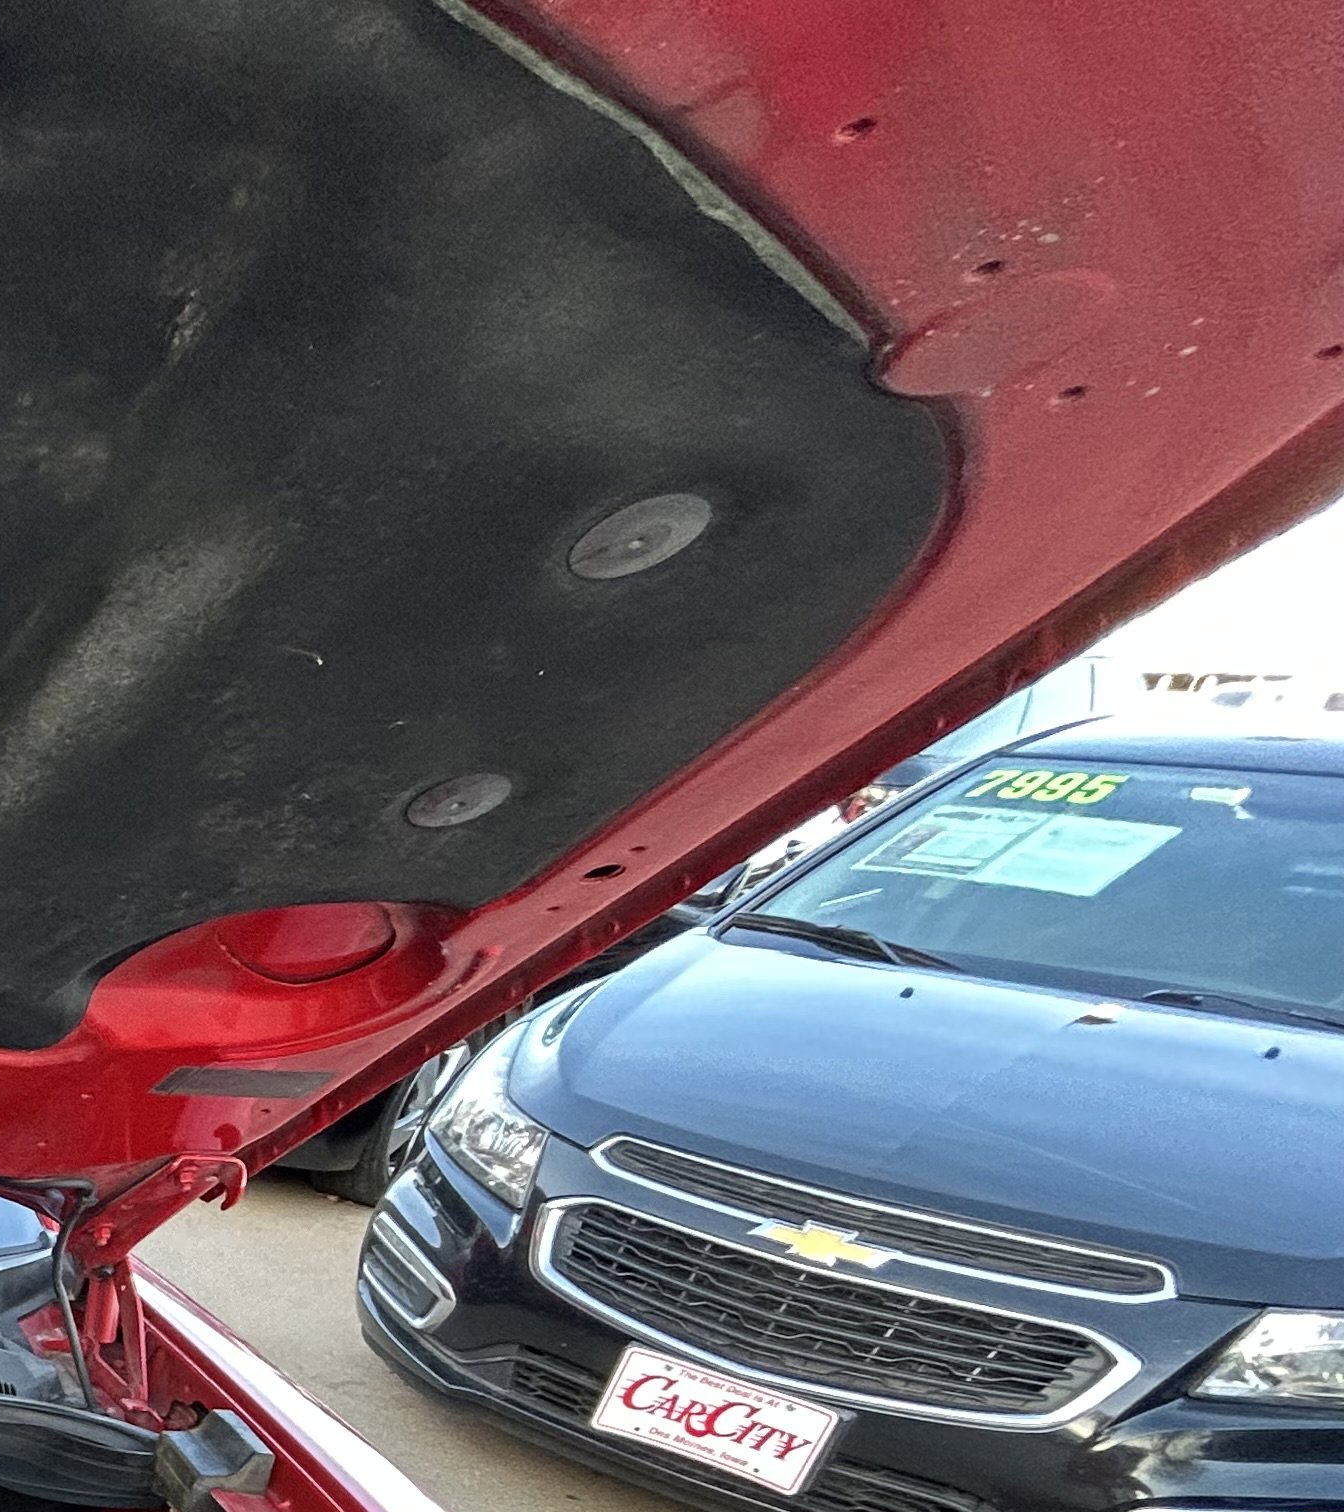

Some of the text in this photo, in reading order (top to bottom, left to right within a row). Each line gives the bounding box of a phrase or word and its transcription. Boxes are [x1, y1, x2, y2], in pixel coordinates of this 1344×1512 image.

[965, 769, 1130, 804] 7995
[679, 1368, 699, 1381] The
[699, 1376, 726, 1390] Best
[727, 1384, 751, 1398] Deal
[648, 1426, 671, 1441] Des
